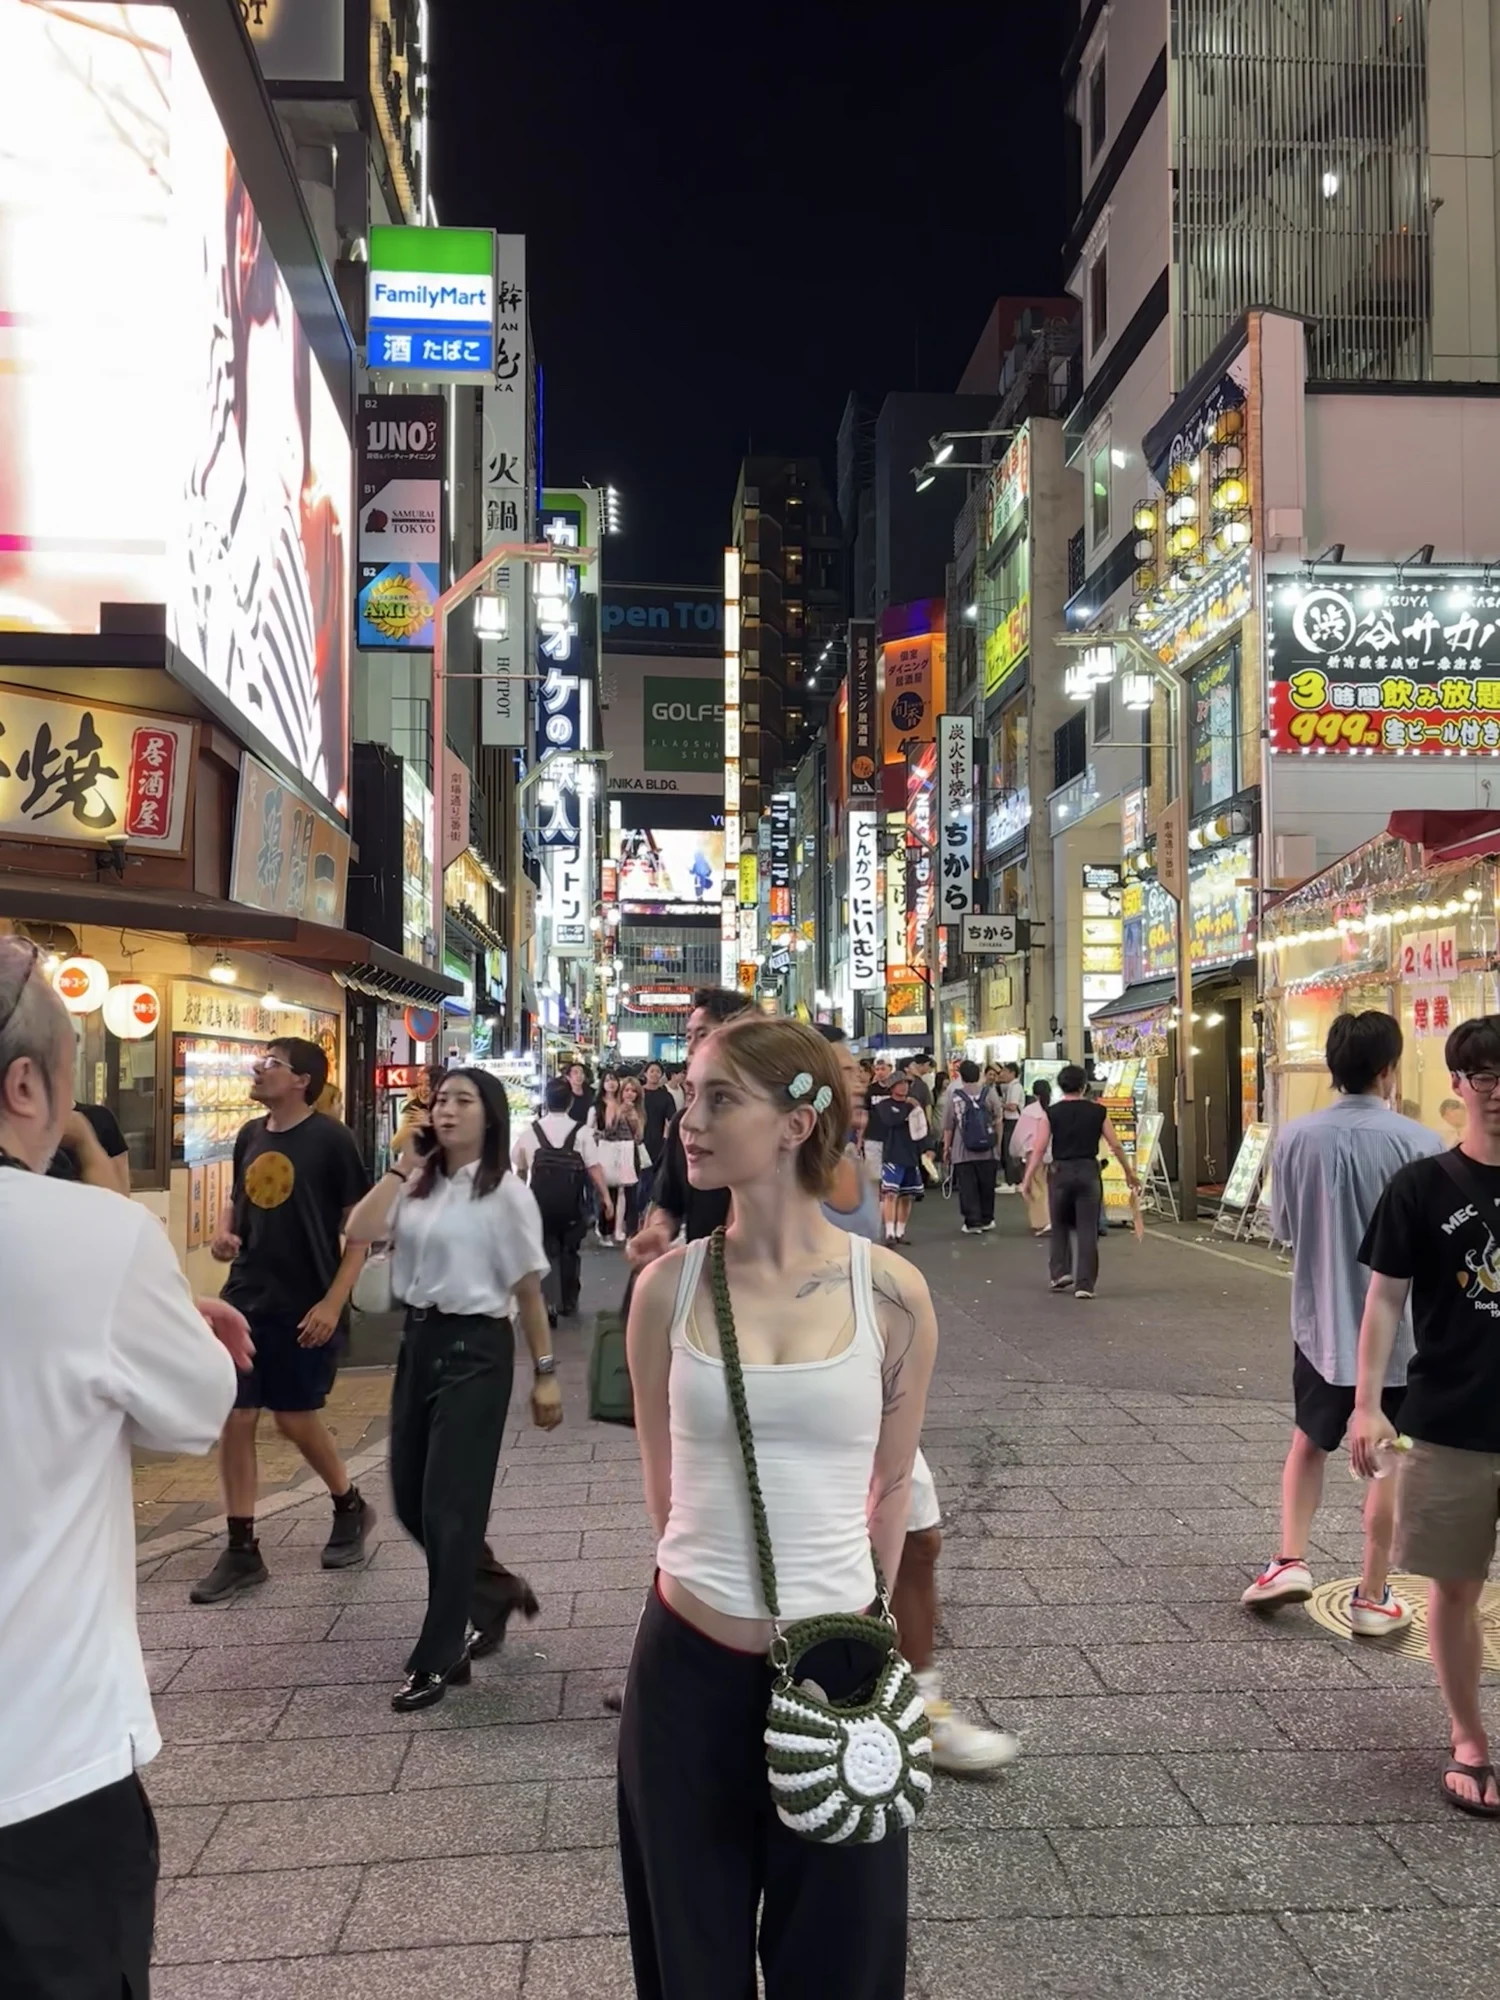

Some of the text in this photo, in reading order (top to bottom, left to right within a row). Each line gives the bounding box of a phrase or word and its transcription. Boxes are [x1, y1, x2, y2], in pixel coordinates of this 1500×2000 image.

[375, 283, 486, 308] FamilyMart
[383, 335, 480, 362] 酒 たばこ
[494, 383, 513, 392] KA
[365, 400, 378, 408] B2
[427, 421, 437, 451] ウーノ
[364, 484, 376, 494] B1
[487, 453, 520, 531] 火鍋
[393, 524, 436, 533] TOKYO
[363, 568, 376, 577] B2
[363, 602, 435, 618] AMIGO
[888, 659, 930, 677] ダイニング
[0, 711, 120, 829] 焼
[131, 737, 166, 831] 居酒屋
[450, 773, 461, 842] 劇場通り一番街
[944, 823, 970, 910] ちから
[854, 821, 874, 979] とんかつ にいむら
[968, 926, 1013, 941] ちから
[1404, 940, 1454, 974] 24H
[1413, 996, 1449, 1029] 営業
[1441, 1203, 1478, 1235] MEC
